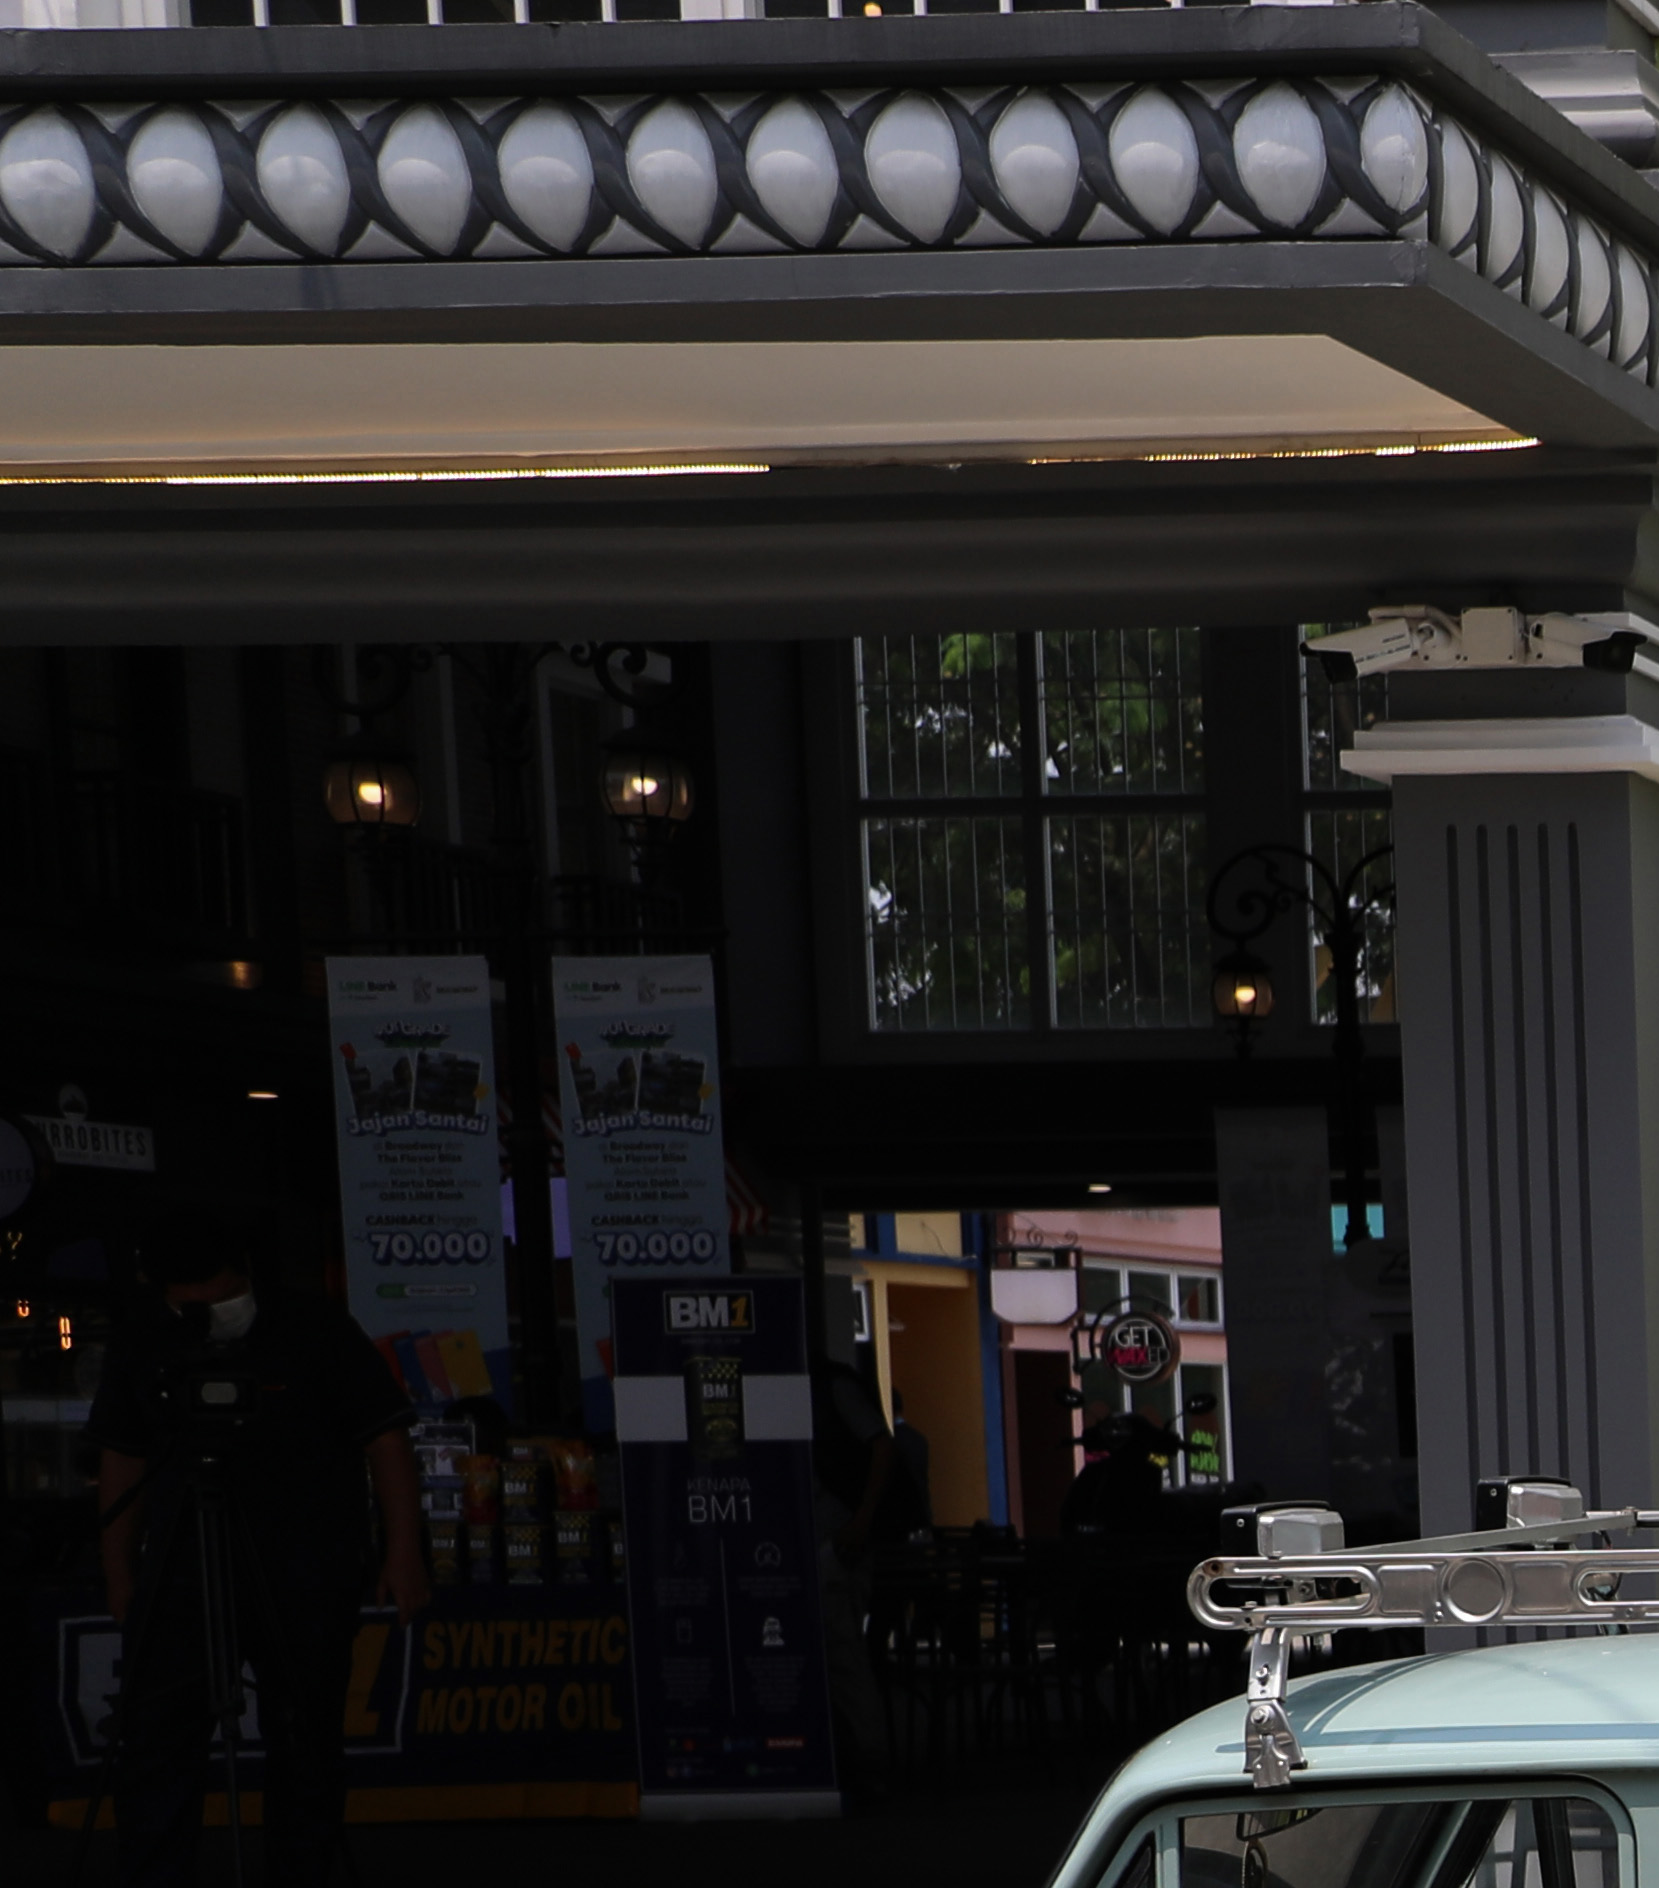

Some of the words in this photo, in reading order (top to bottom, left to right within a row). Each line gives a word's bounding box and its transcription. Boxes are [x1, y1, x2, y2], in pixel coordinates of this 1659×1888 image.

[348, 1111, 410, 1134] Jajan
[414, 1111, 488, 1132] Santai
[573, 1111, 635, 1134] Jajan
[639, 1111, 713, 1132] Santai
[40, 1121, 146, 1156] RROBITES
[365, 1214, 435, 1225] CASHBACK
[591, 1214, 659, 1225] CASHBACK
[371, 1232, 488, 1261] 70.000
[596, 1232, 714, 1261] 70.000
[669, 1295, 749, 1329] BM1
[1115, 1325, 1153, 1347] GET
[687, 1476, 752, 1492] KENAPA
[687, 1494, 752, 1523] BM1
[422, 1616, 627, 1669] SYNTHETIC
[416, 1682, 549, 1735] MOTOR
[558, 1681, 624, 1731] OIL
